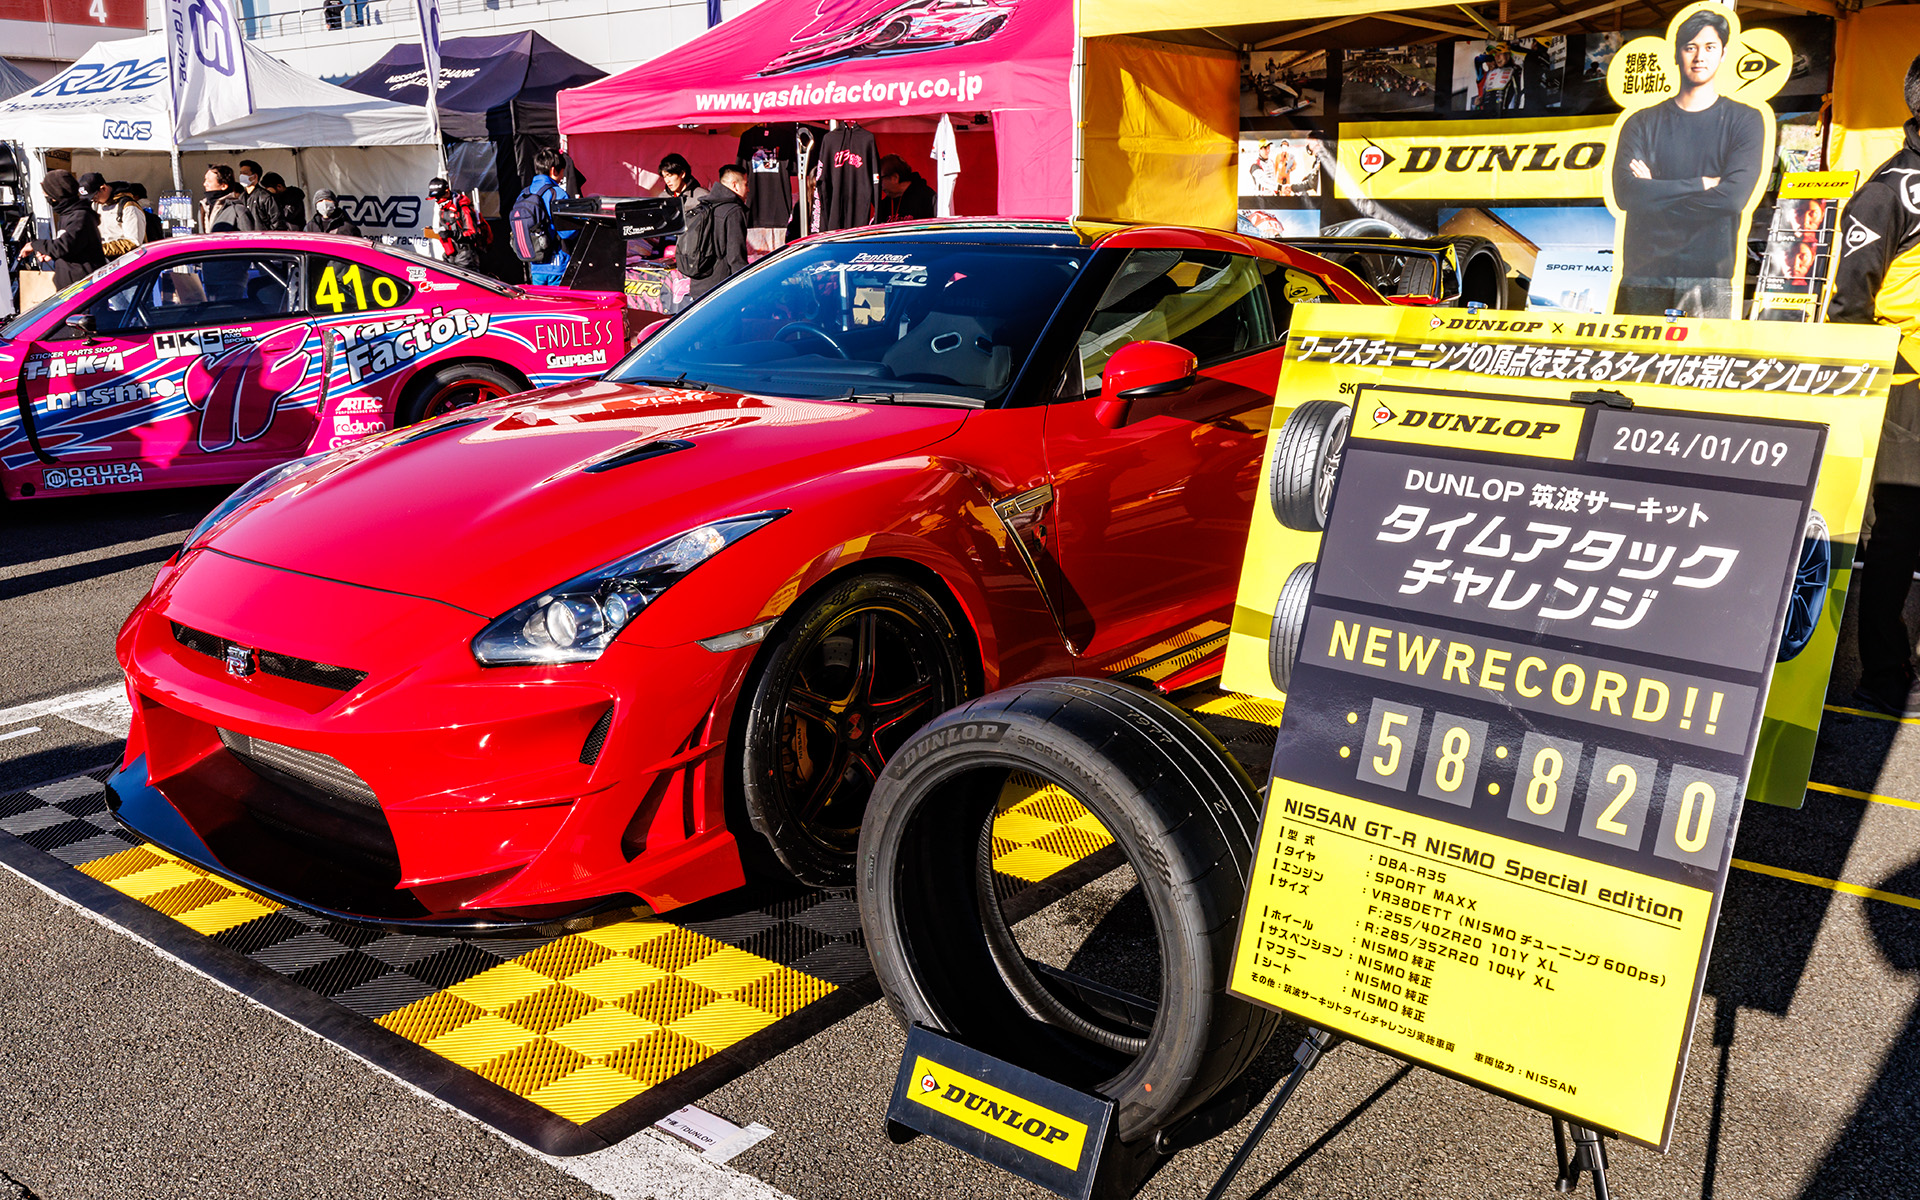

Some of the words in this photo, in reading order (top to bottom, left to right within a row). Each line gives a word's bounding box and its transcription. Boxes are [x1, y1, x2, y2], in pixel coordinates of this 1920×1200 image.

[89, 0, 107, 23] 4
[440, 68, 480, 78] CHANIC
[1624, 53, 1661, 73] 想像を、
[695, 71, 983, 114] www.yashiofactory.co.jp
[1623, 73, 1671, 94] 追い抜け。
[103, 119, 152, 140] RAYS
[1400, 142, 1607, 173] DUNLO
[337, 195, 421, 228] RAYS
[829, 264, 927, 273] DUNLOP
[156, 330, 221, 350] HKS
[222, 326, 252, 334] POWER
[535, 320, 613, 350] ENDLESS
[1446, 318, 1543, 333] DUNLOP
[1575, 321, 1688, 341] nismo
[29, 351, 64, 361] STICKER
[67, 347, 93, 357] PARTS
[95, 345, 118, 354] SHOP
[346, 309, 490, 385] Factory
[546, 348, 606, 369] GruppeM
[335, 396, 383, 411] ARTEC
[1398, 409, 1560, 439] DUNLOP
[1613, 426, 1788, 467] 2024/01/09
[67, 462, 142, 478] OGURA
[70, 472, 143, 488] CLUTCH
[1405, 469, 1524, 503] DUNLOP
[1530, 482, 1709, 529] 筑波サーキット
[1375, 502, 1740, 590] タイムアタック
[1398, 557, 1659, 630] チャレンジ
[902, 724, 1000, 770] DUNLOP
[1017, 735, 1063, 760] SPORT
[1063, 756, 1102, 791] MAXX
[1284, 798, 1356, 831] NISSAN
[1364, 820, 1417, 848] GT-R
[1425, 836, 1495, 870] NISMO
[1504, 858, 1588, 896] Special
[1598, 886, 1683, 922] edition
[1281, 861, 1324, 882] エンジン
[1372, 888, 1452, 921] VR38DETT
[1284, 845, 1316, 862] タイヤ
[1375, 871, 1426, 896] SPORT
[1433, 889, 1478, 911] MAXX
[1271, 909, 1314, 931] ホイール
[1278, 876, 1310, 896] サイズ
[1491, 943, 1529, 963] 101Y
[1537, 957, 1559, 974] XL
[1266, 940, 1307, 960] マフラー
[1268, 925, 1343, 957] サスペンション
[1262, 956, 1292, 974] シート
[1488, 960, 1526, 981] 104Y
[1533, 974, 1555, 992] XL
[940, 1082, 1069, 1145] DUNLOP
